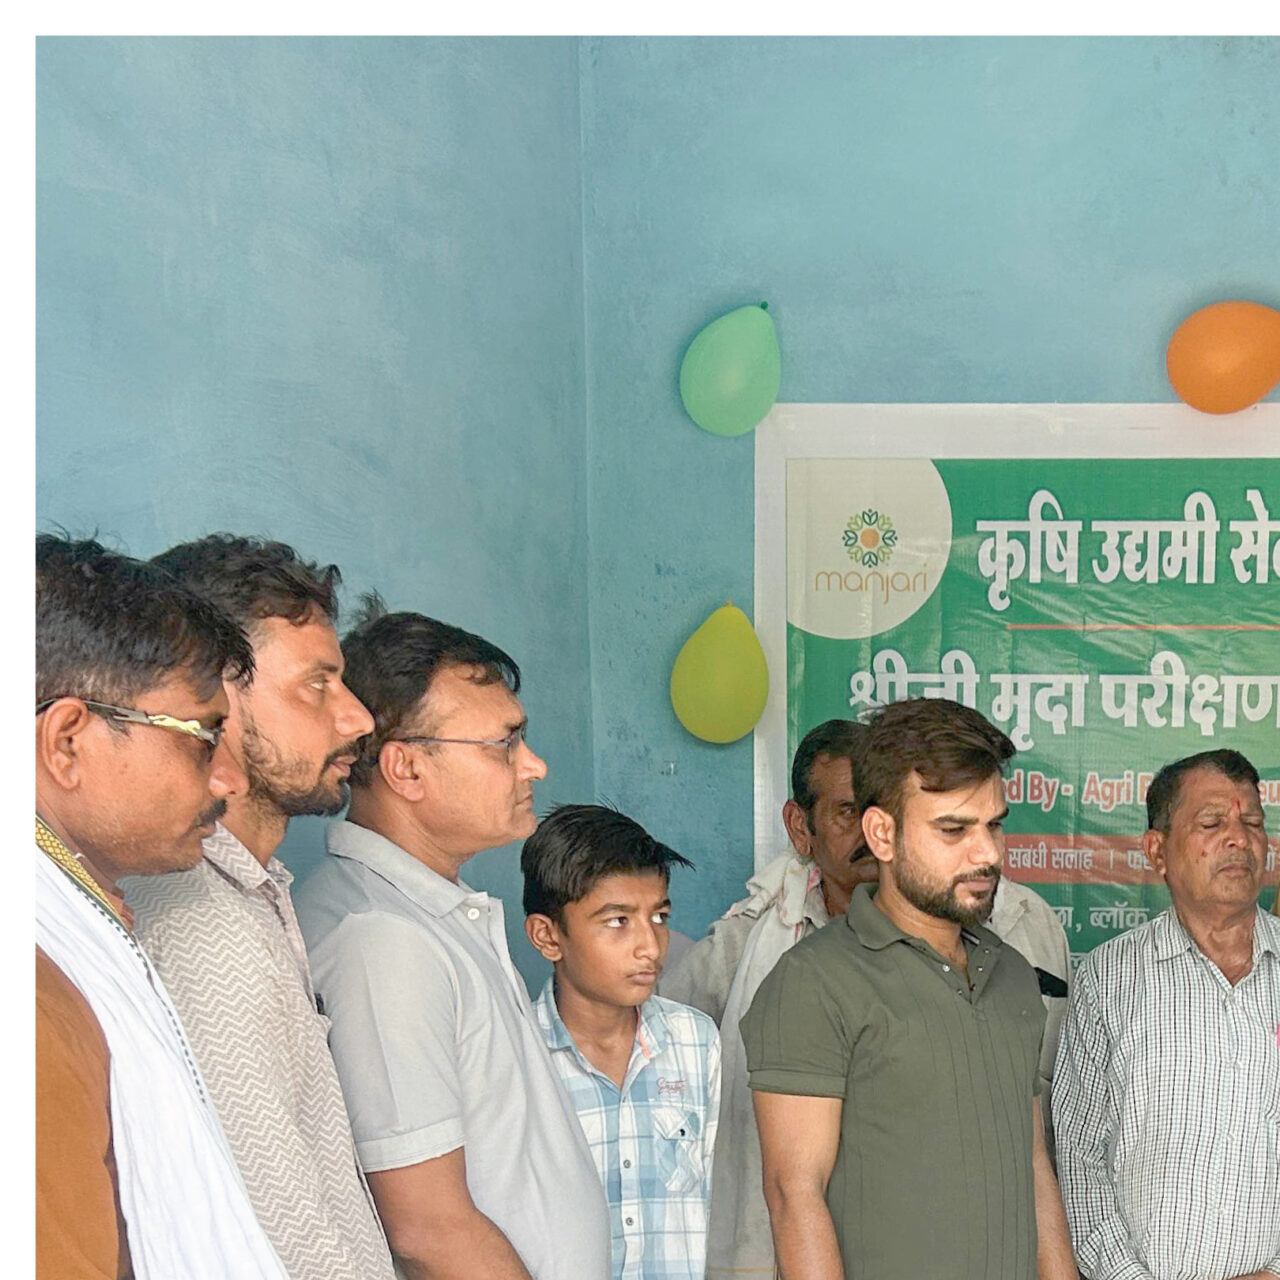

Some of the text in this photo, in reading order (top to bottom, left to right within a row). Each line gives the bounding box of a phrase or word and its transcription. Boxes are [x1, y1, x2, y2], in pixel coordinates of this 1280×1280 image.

[976, 489, 1083, 611] कृषि
[1091, 491, 1220, 584] उद्यमी
[815, 562, 927, 605] manjari
[990, 673, 1089, 751] मृदा
[1028, 771, 1059, 811] By
[1081, 769, 1134, 812] Agri
